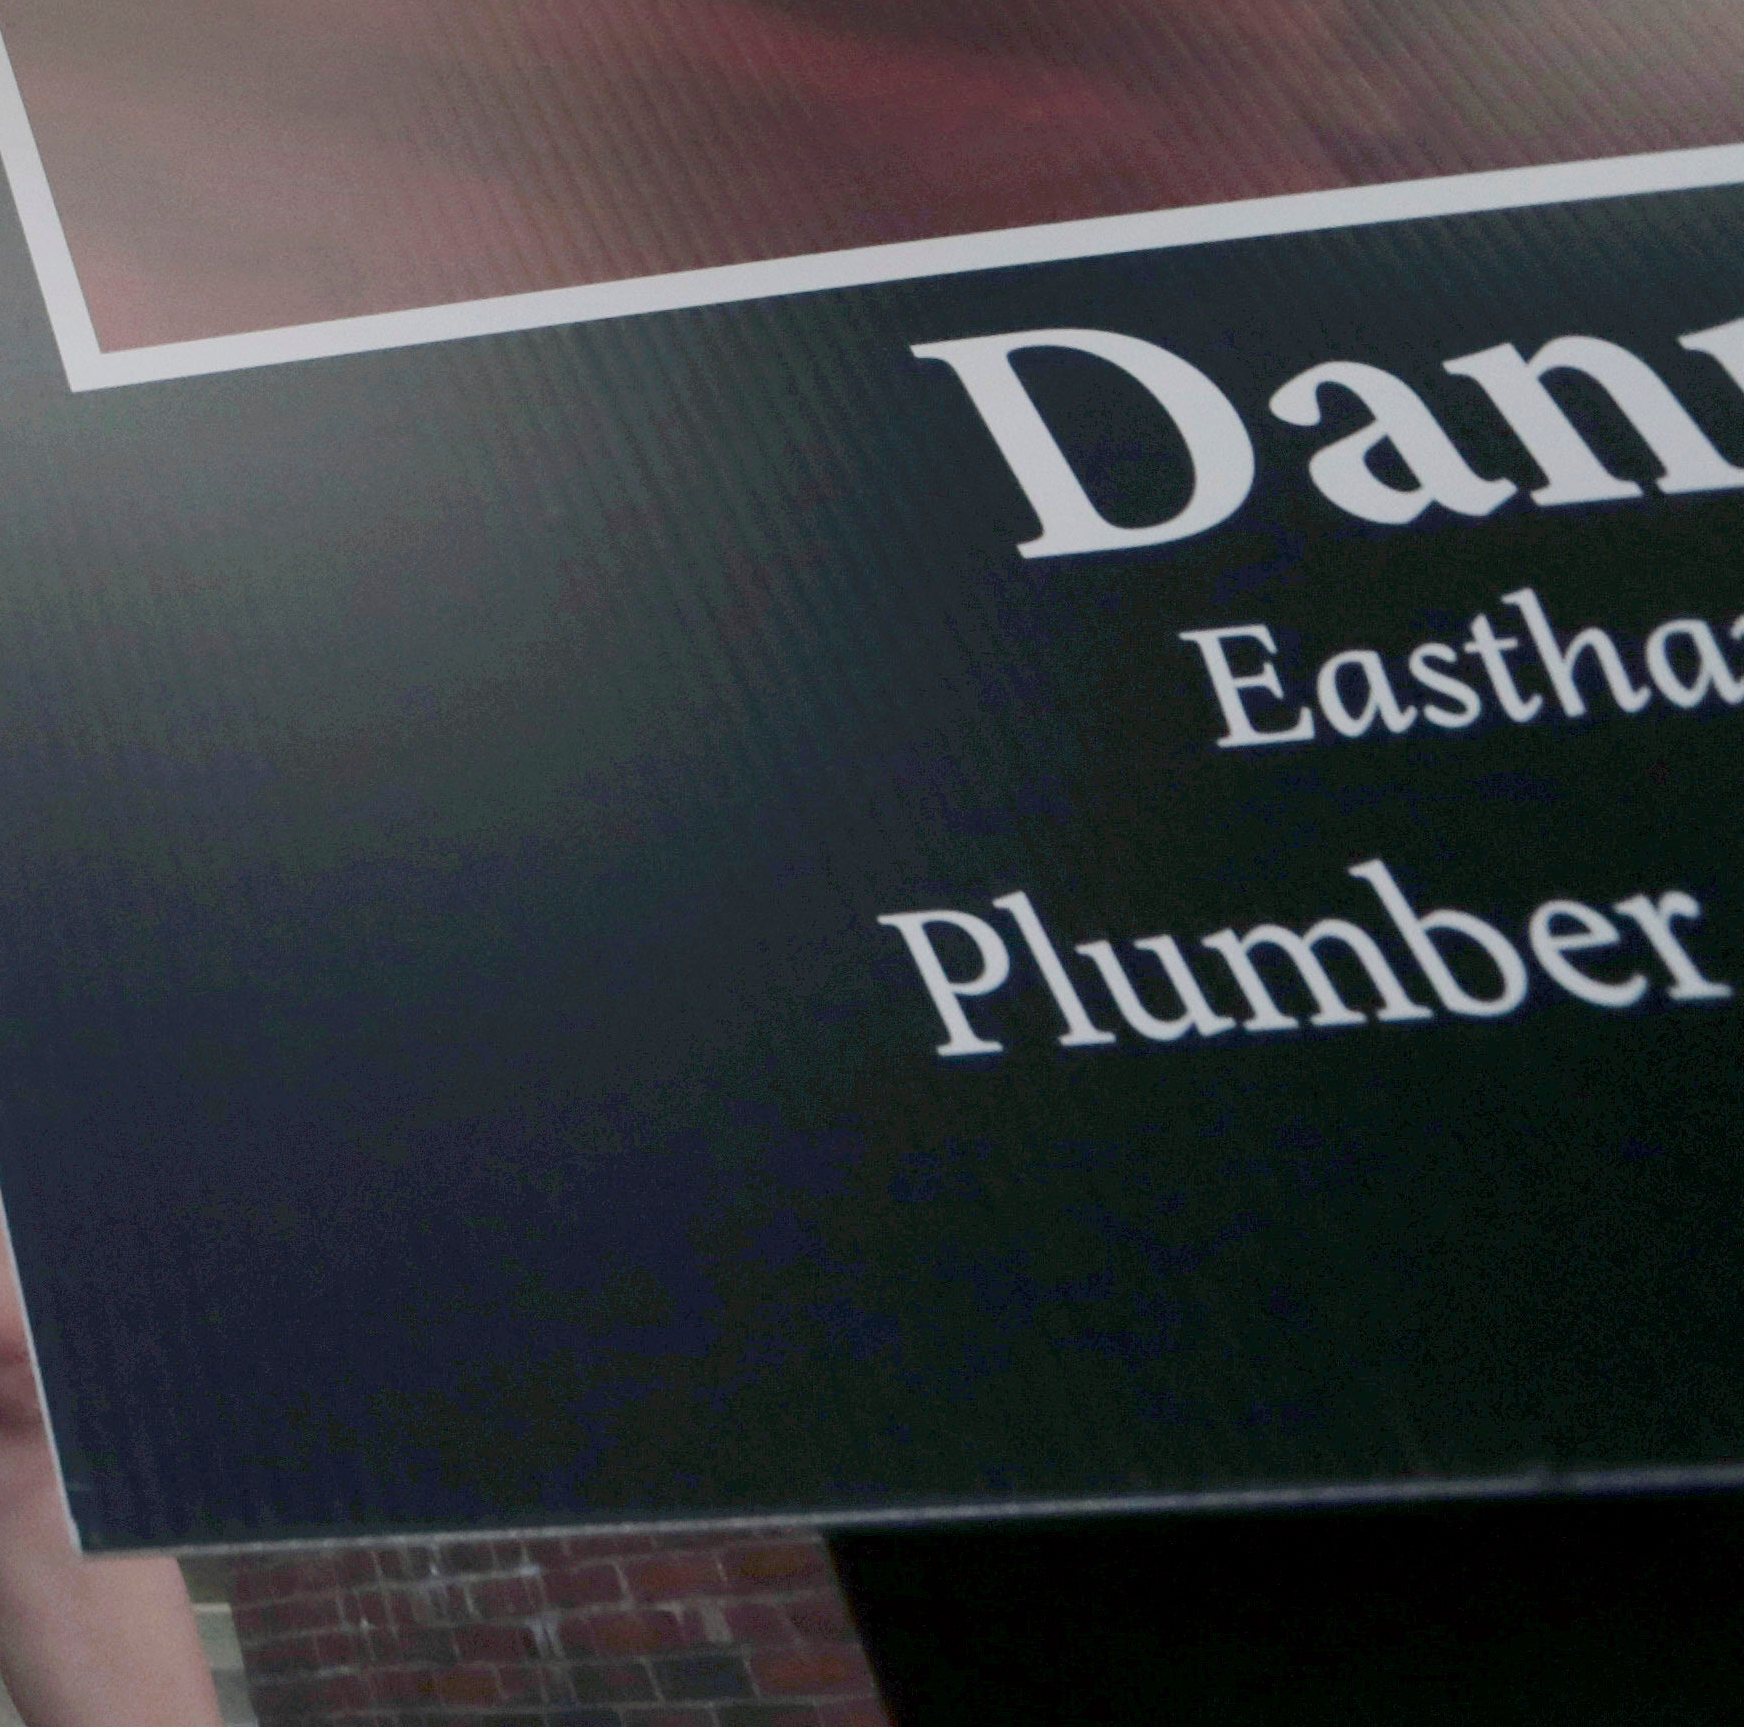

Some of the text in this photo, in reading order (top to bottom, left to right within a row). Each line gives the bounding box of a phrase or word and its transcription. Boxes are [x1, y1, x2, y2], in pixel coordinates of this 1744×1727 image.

[909, 318, 1744, 561] Dan
[1181, 587, 1744, 749] Eastha
[876, 858, 1733, 1057] Plumber
